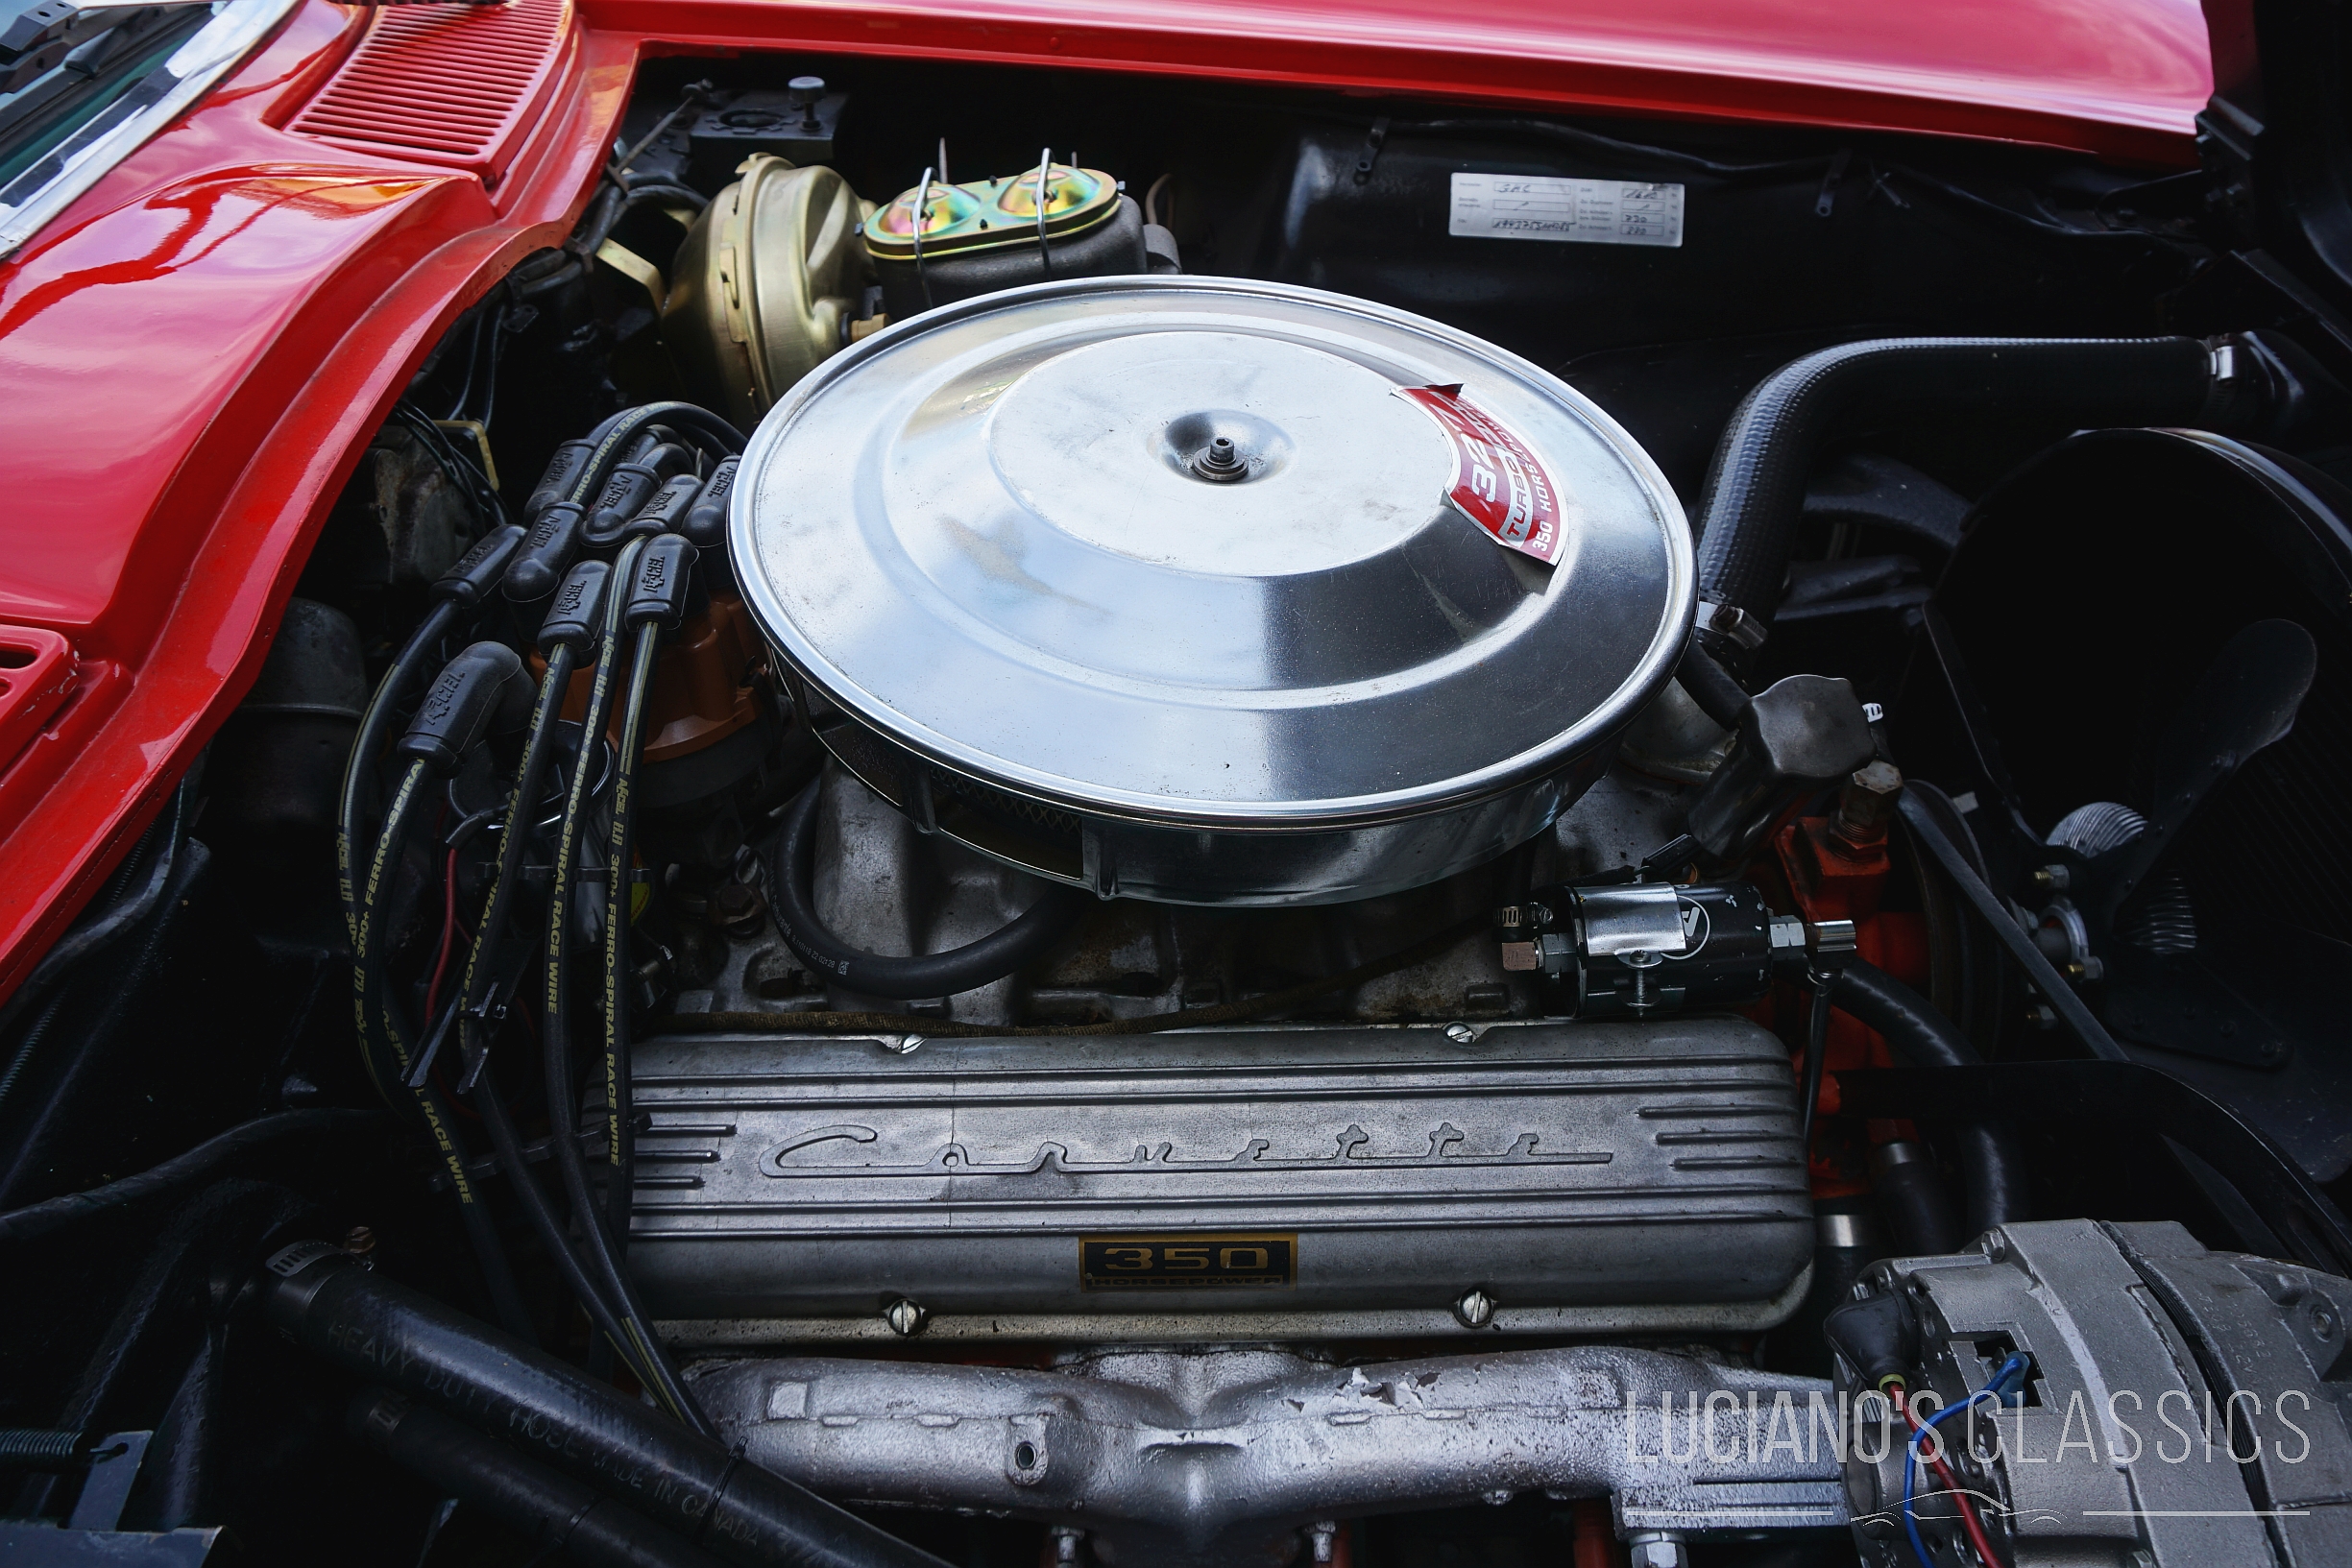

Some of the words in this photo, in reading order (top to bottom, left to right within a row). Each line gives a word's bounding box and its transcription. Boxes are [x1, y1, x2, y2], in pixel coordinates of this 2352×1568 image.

[1429, 403, 1497, 503] 327
[1532, 520, 1553, 553] 350
[583, 704, 600, 749] 300+
[517, 738, 533, 783] 300+
[554, 750, 590, 895] FERRO-SPIRAL
[609, 854, 620, 898] 300+
[356, 910, 371, 959] 300+
[548, 900, 565, 957] RACE
[463, 934, 483, 993] RACE
[547, 961, 559, 1014] WIRE
[605, 903, 618, 1048] FERRO-SPIRAL
[606, 1052, 618, 1110] RACE
[421, 1100, 452, 1151] RACE
[446, 1155, 473, 1204] WIRE
[609, 1114, 619, 1167] WIRE
[1094, 1277, 1283, 1286] HORSEPOWER
[1104, 1247, 1269, 1270] 350
[592, 1453, 643, 1489] MADE
[654, 1478, 678, 1505] IN
